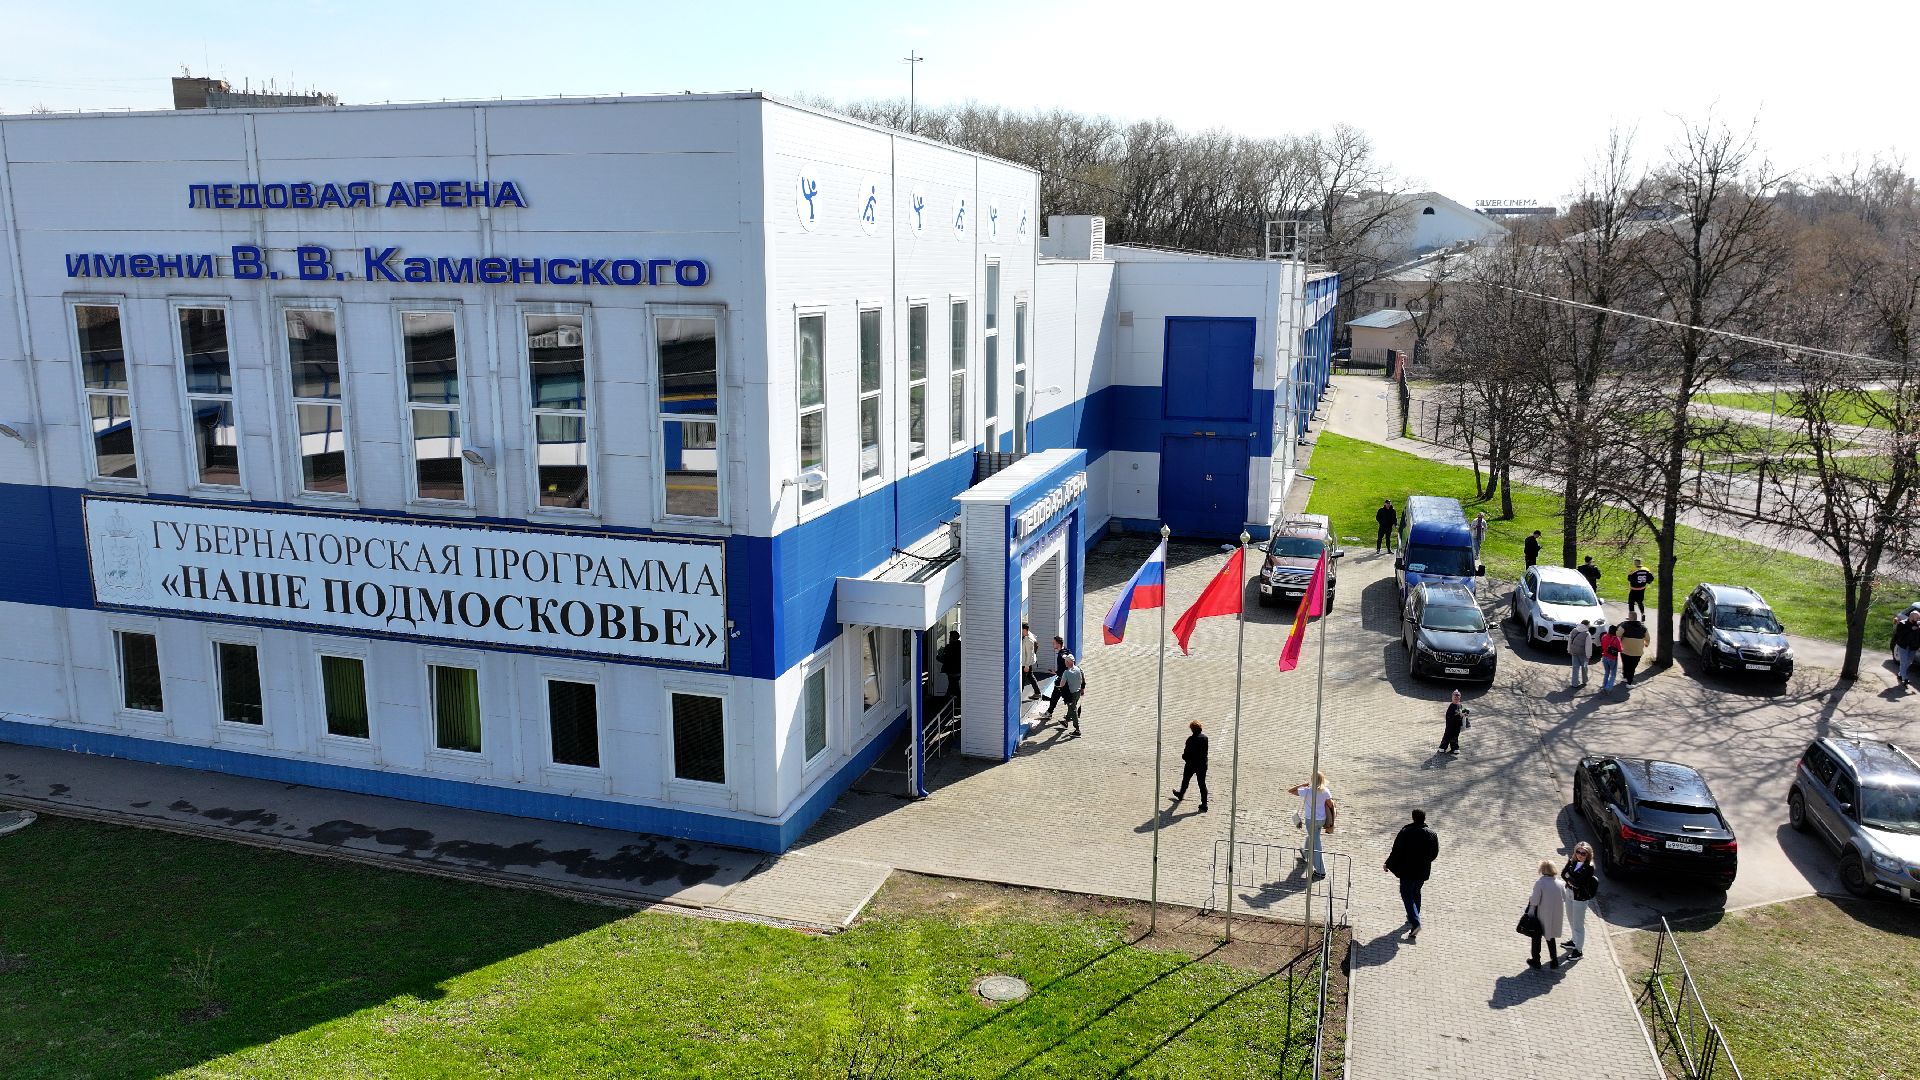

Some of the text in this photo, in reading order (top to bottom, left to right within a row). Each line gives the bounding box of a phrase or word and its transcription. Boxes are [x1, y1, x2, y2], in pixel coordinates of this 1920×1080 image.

[189, 178, 526, 210] ЛЕДОВАЯ АРЕНА
[1475, 199, 1538, 207] SILVER CINEMA
[65, 244, 710, 288] имени В. В. Каменского
[152, 519, 721, 597] ГУБЕРНАТОРСКАЯ ПРОГРАММА
[161, 564, 719, 648] «НАШЕ ПОДМОСКОВЬЕ»
